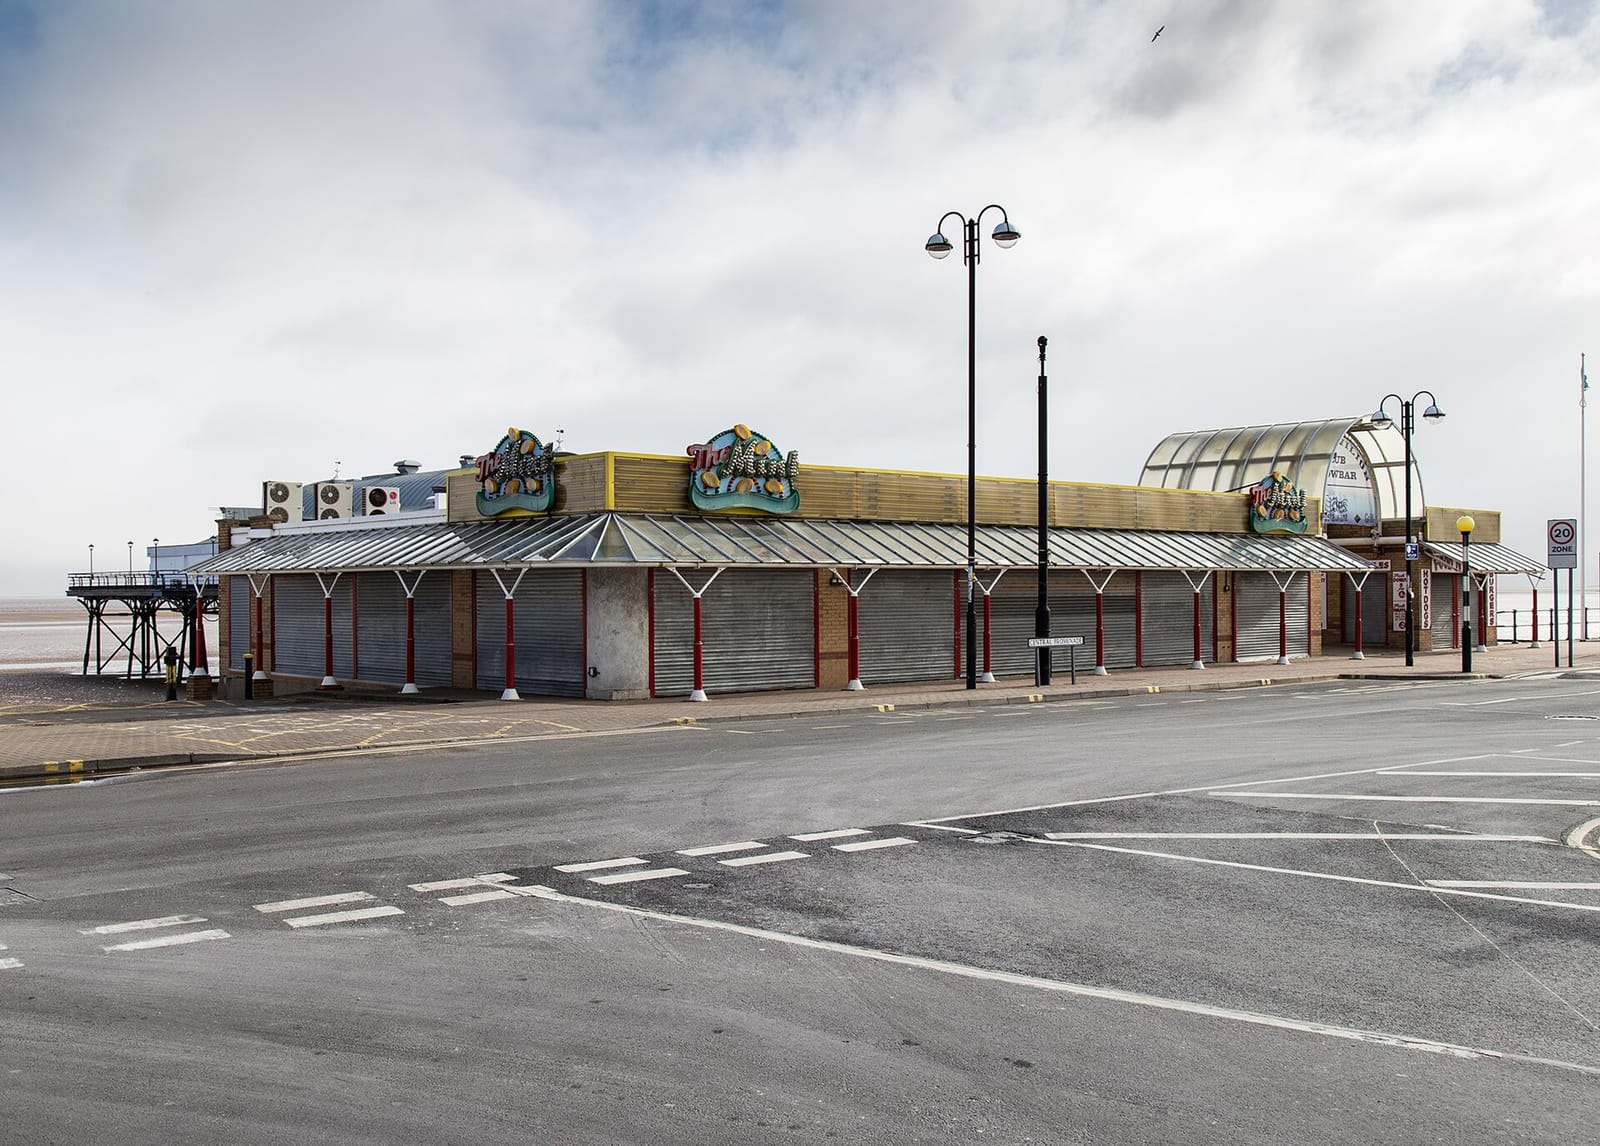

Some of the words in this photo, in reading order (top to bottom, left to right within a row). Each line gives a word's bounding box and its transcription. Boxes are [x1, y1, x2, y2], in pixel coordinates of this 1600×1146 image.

[475, 452, 502, 482] The
[687, 443, 730, 472] The
[1249, 486, 1272, 506] The
[1554, 528, 1571, 538] 20
